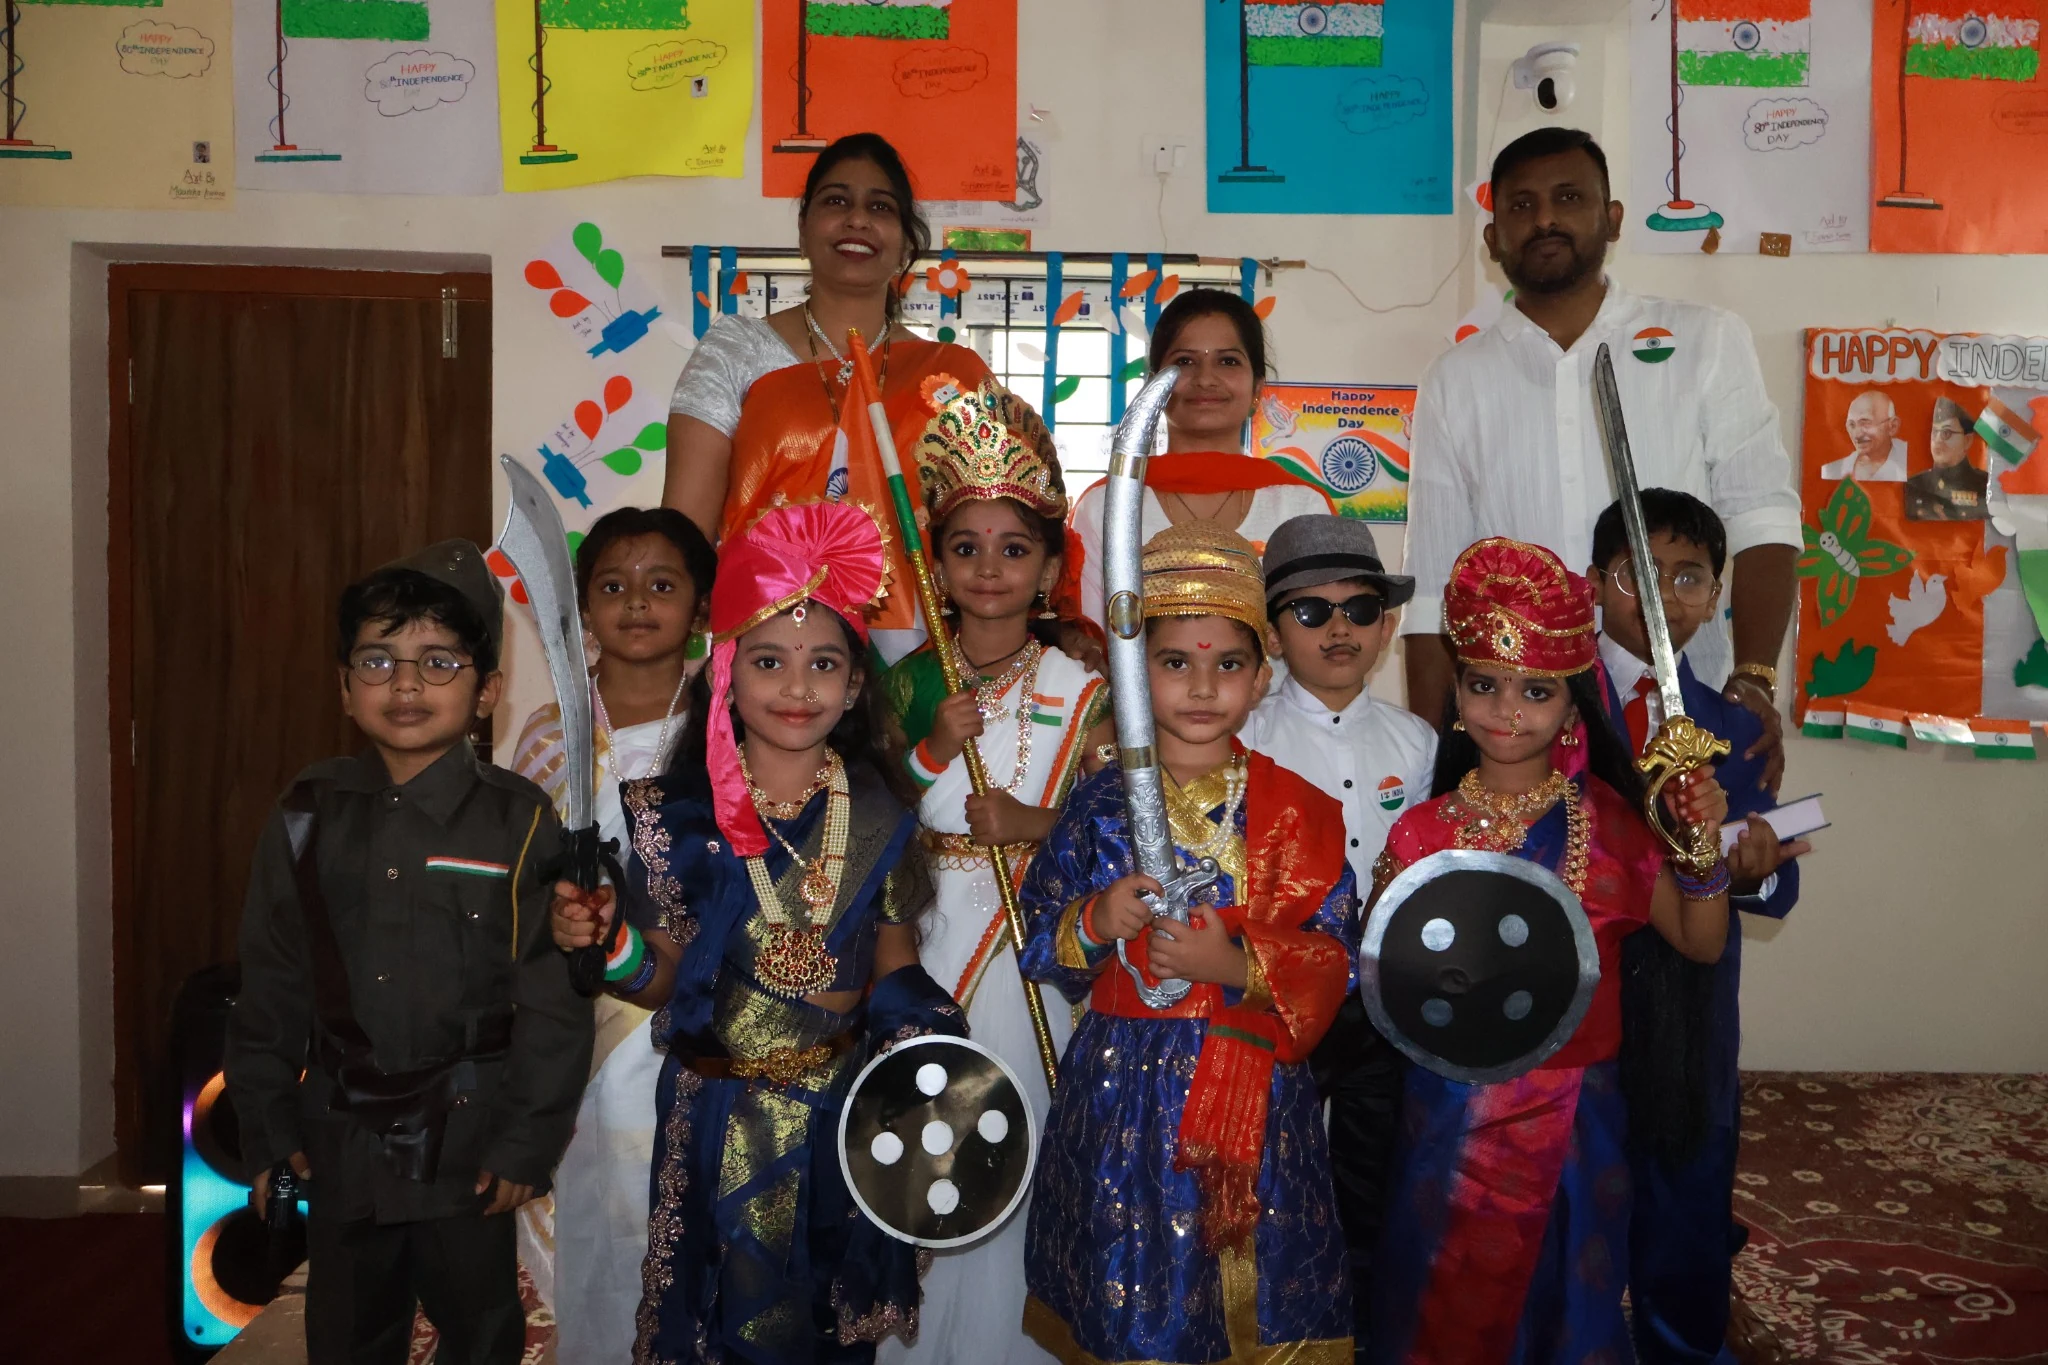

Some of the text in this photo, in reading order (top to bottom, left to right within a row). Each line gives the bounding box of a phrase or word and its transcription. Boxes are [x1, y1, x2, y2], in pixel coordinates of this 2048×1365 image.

[140, 33, 173, 44] HAPPY
[140, 46, 204, 55] INDEPENDENCE
[654, 49, 683, 64] HAPPY
[652, 52, 718, 72] INDEPENDENCE
[401, 63, 437, 75] HAPPY
[396, 73, 464, 87] INDEPENDENCE
[1766, 107, 1797, 120] HAPPY
[1754, 121, 1770, 134] 80th
[1767, 133, 1789, 144] DAY
[182, 168, 203, 184] Art
[1821, 335, 2048, 383] HAPPY INDE
[1332, 391, 1374, 401] Happy
[1303, 404, 1399, 416] Independence
[1337, 418, 1364, 429] Day
